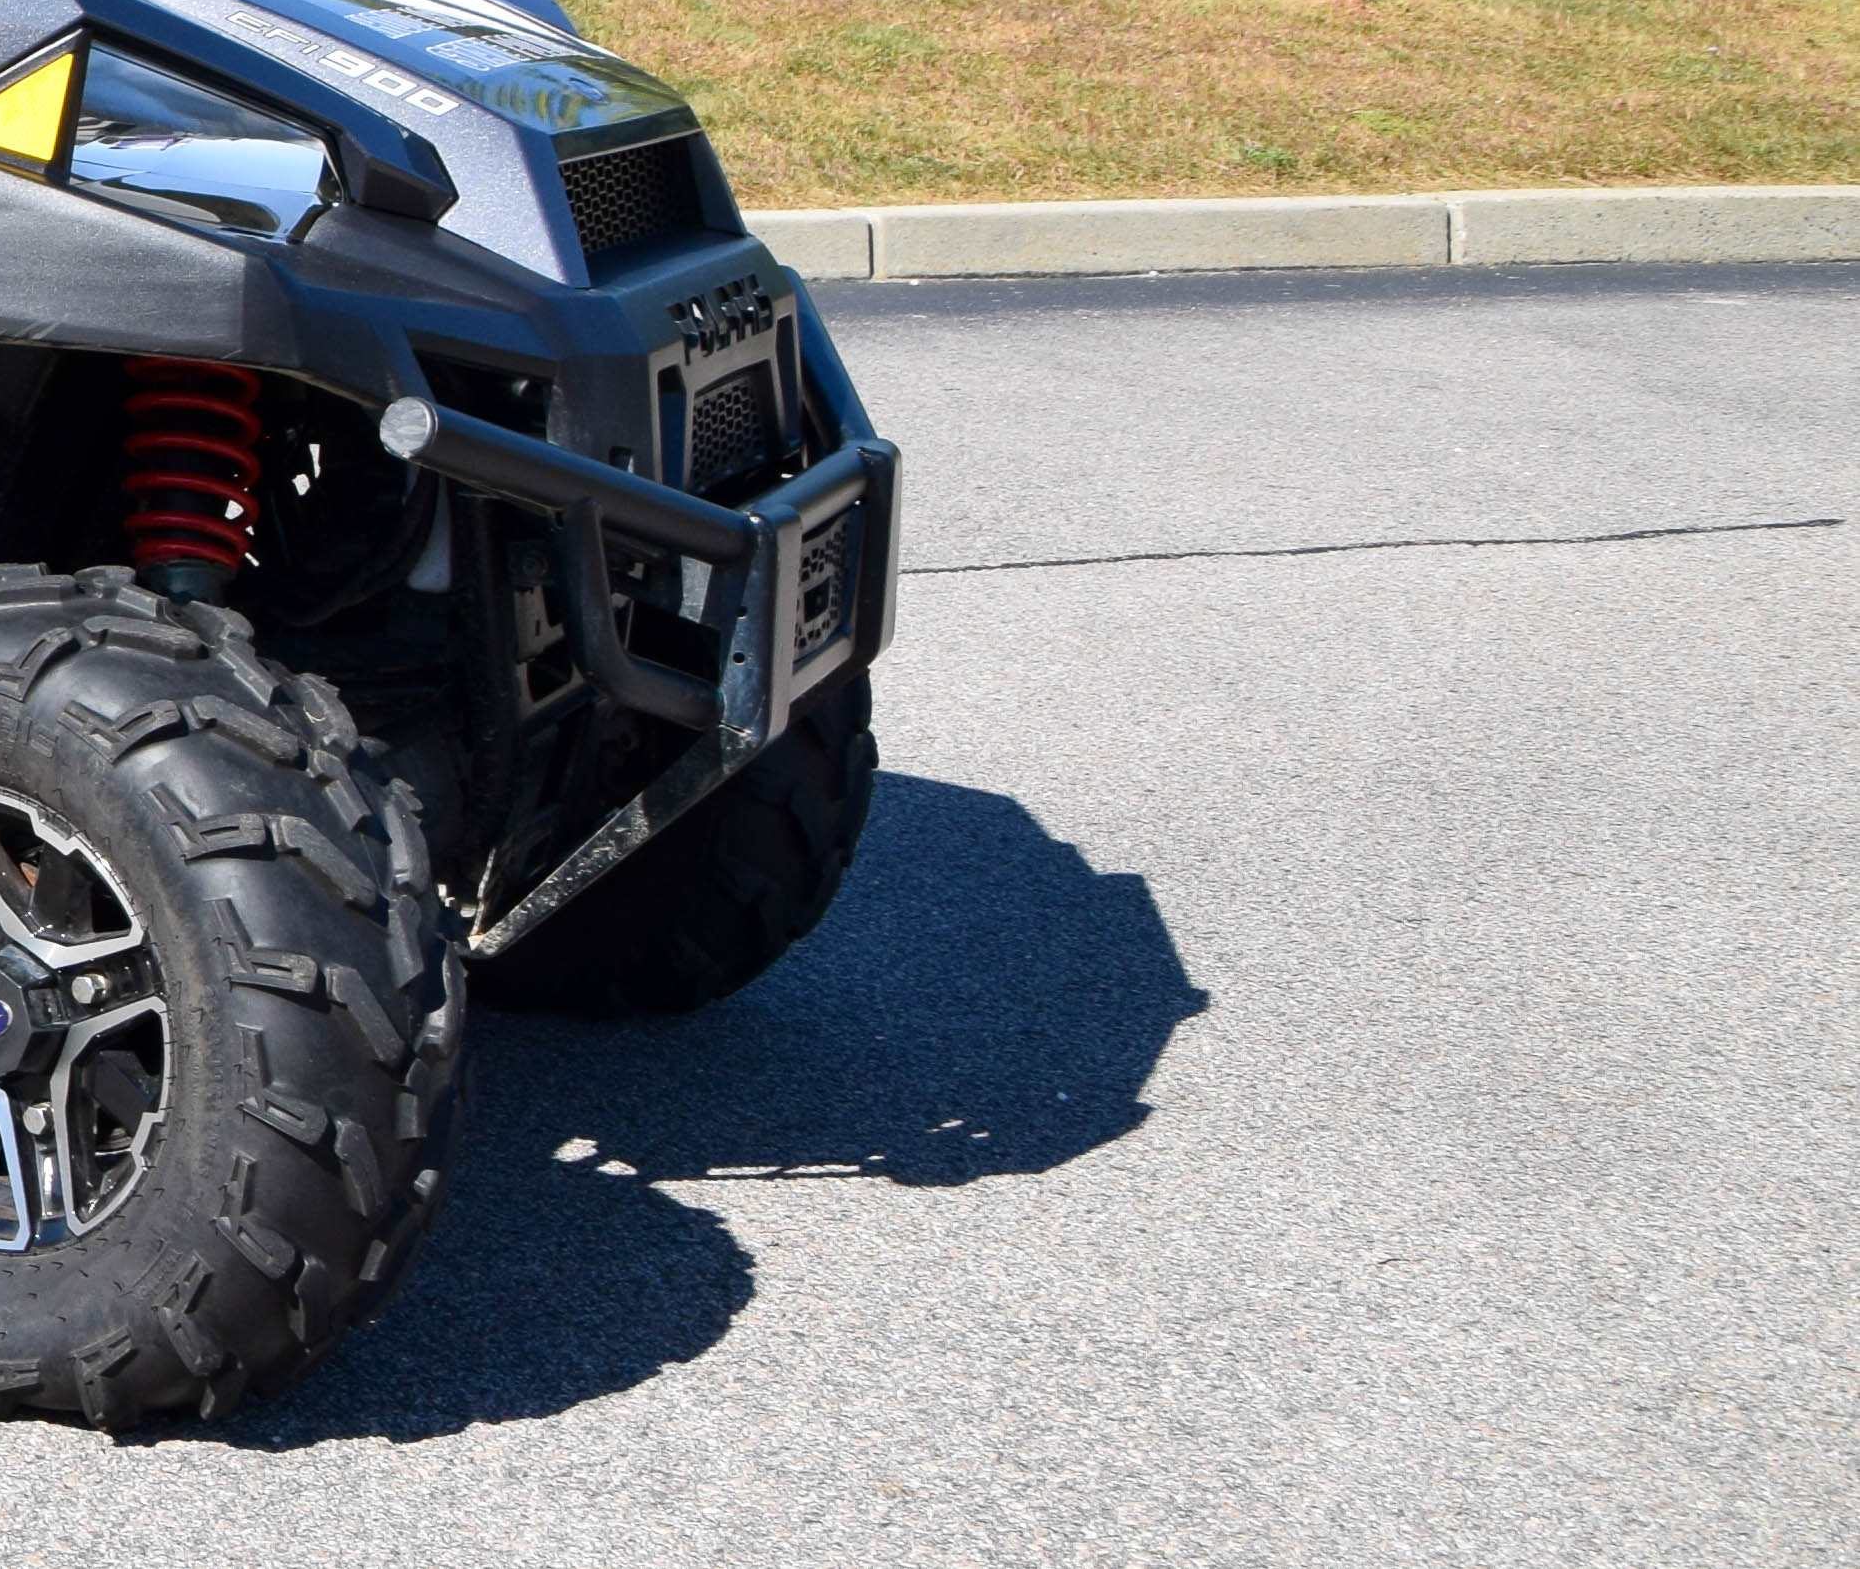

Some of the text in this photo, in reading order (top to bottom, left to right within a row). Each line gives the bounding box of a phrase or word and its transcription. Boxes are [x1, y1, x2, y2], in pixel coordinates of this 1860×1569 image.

[225, 10, 320, 55] EFI
[318, 49, 461, 127] 900
[666, 273, 774, 367] POLARIS
